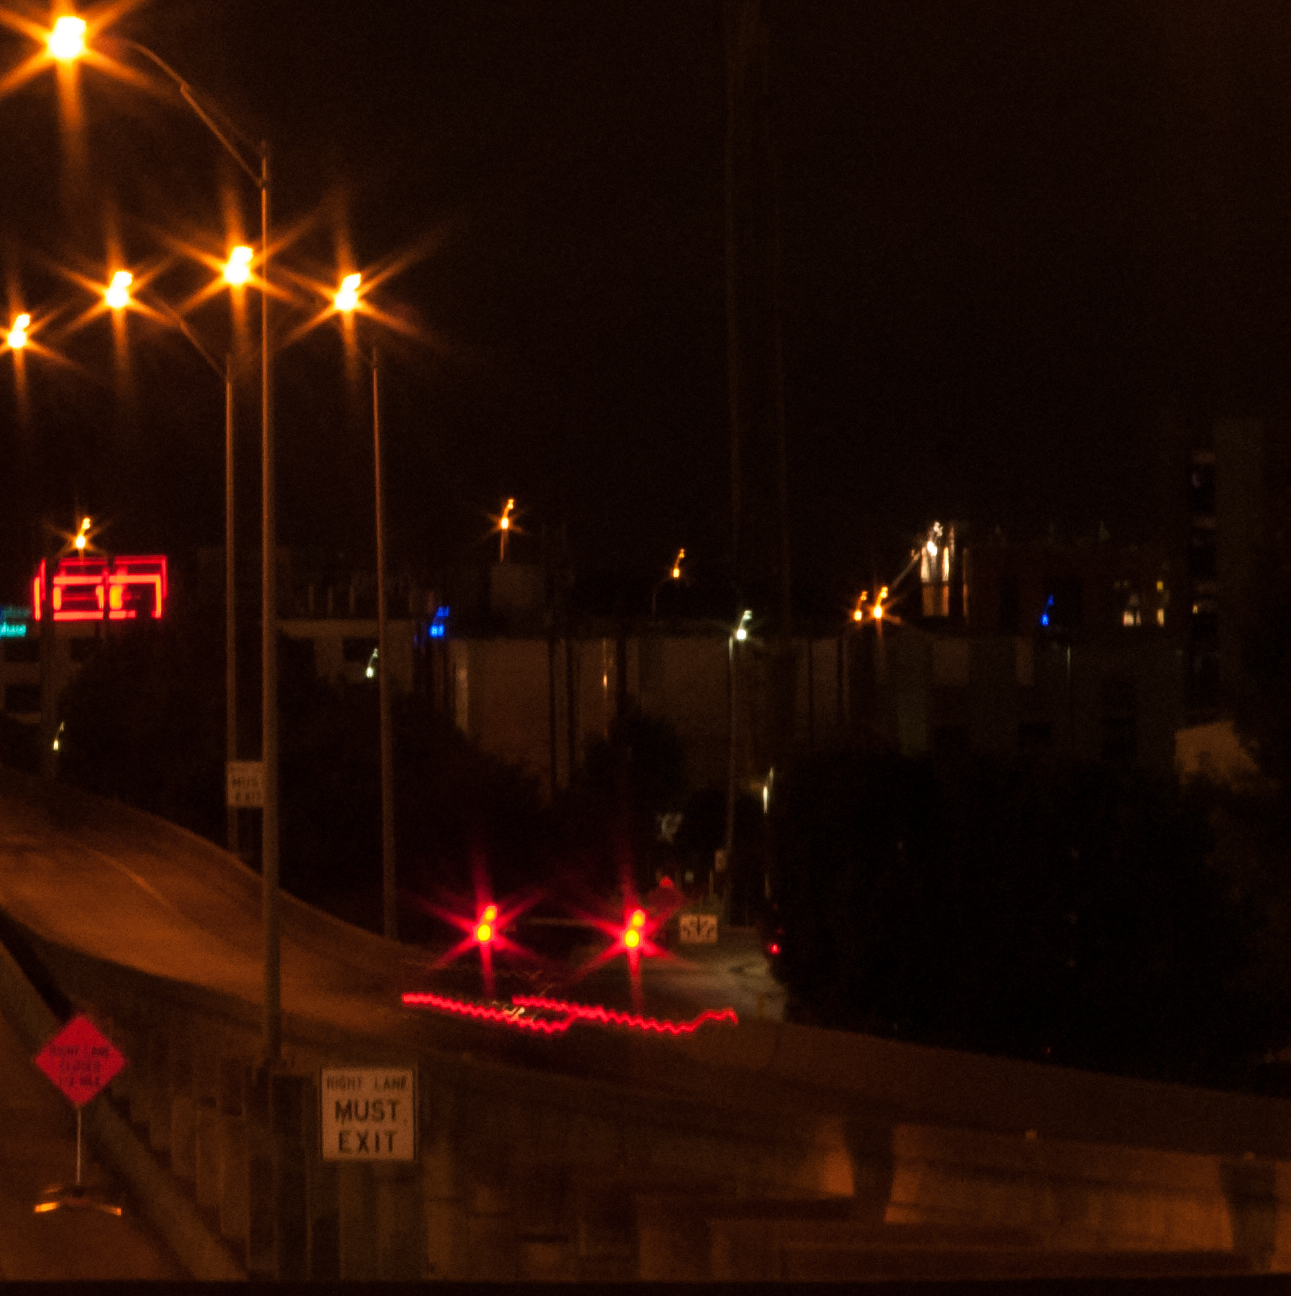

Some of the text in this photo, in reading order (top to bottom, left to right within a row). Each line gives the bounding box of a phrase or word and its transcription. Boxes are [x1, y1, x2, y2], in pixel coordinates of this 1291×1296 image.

[325, 1076, 408, 1090] RIGHT LANE
[335, 1099, 399, 1122] MUST
[339, 1130, 397, 1154] EXIT
